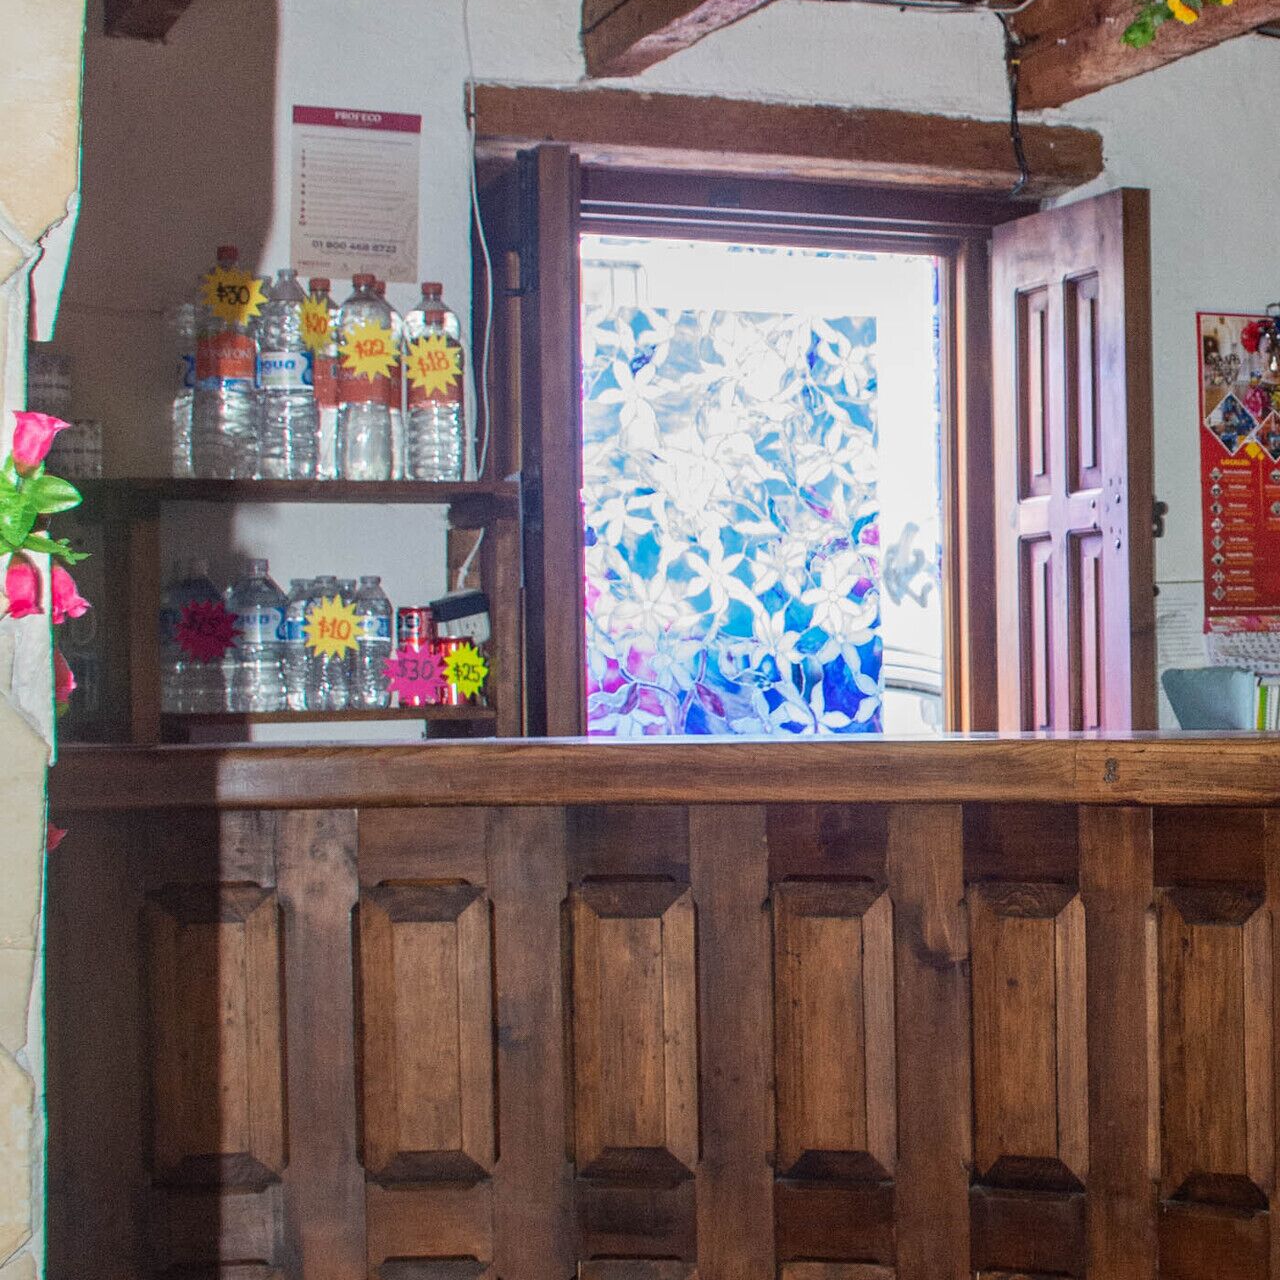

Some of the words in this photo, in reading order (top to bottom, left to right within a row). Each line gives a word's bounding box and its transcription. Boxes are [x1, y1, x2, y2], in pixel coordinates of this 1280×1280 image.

[216, 282, 250, 305] $30
[354, 338, 389, 359] $22
[417, 351, 450, 377] $18
[317, 616, 351, 641] $10
[396, 658, 434, 681] $30
[454, 663, 481, 682] $25
